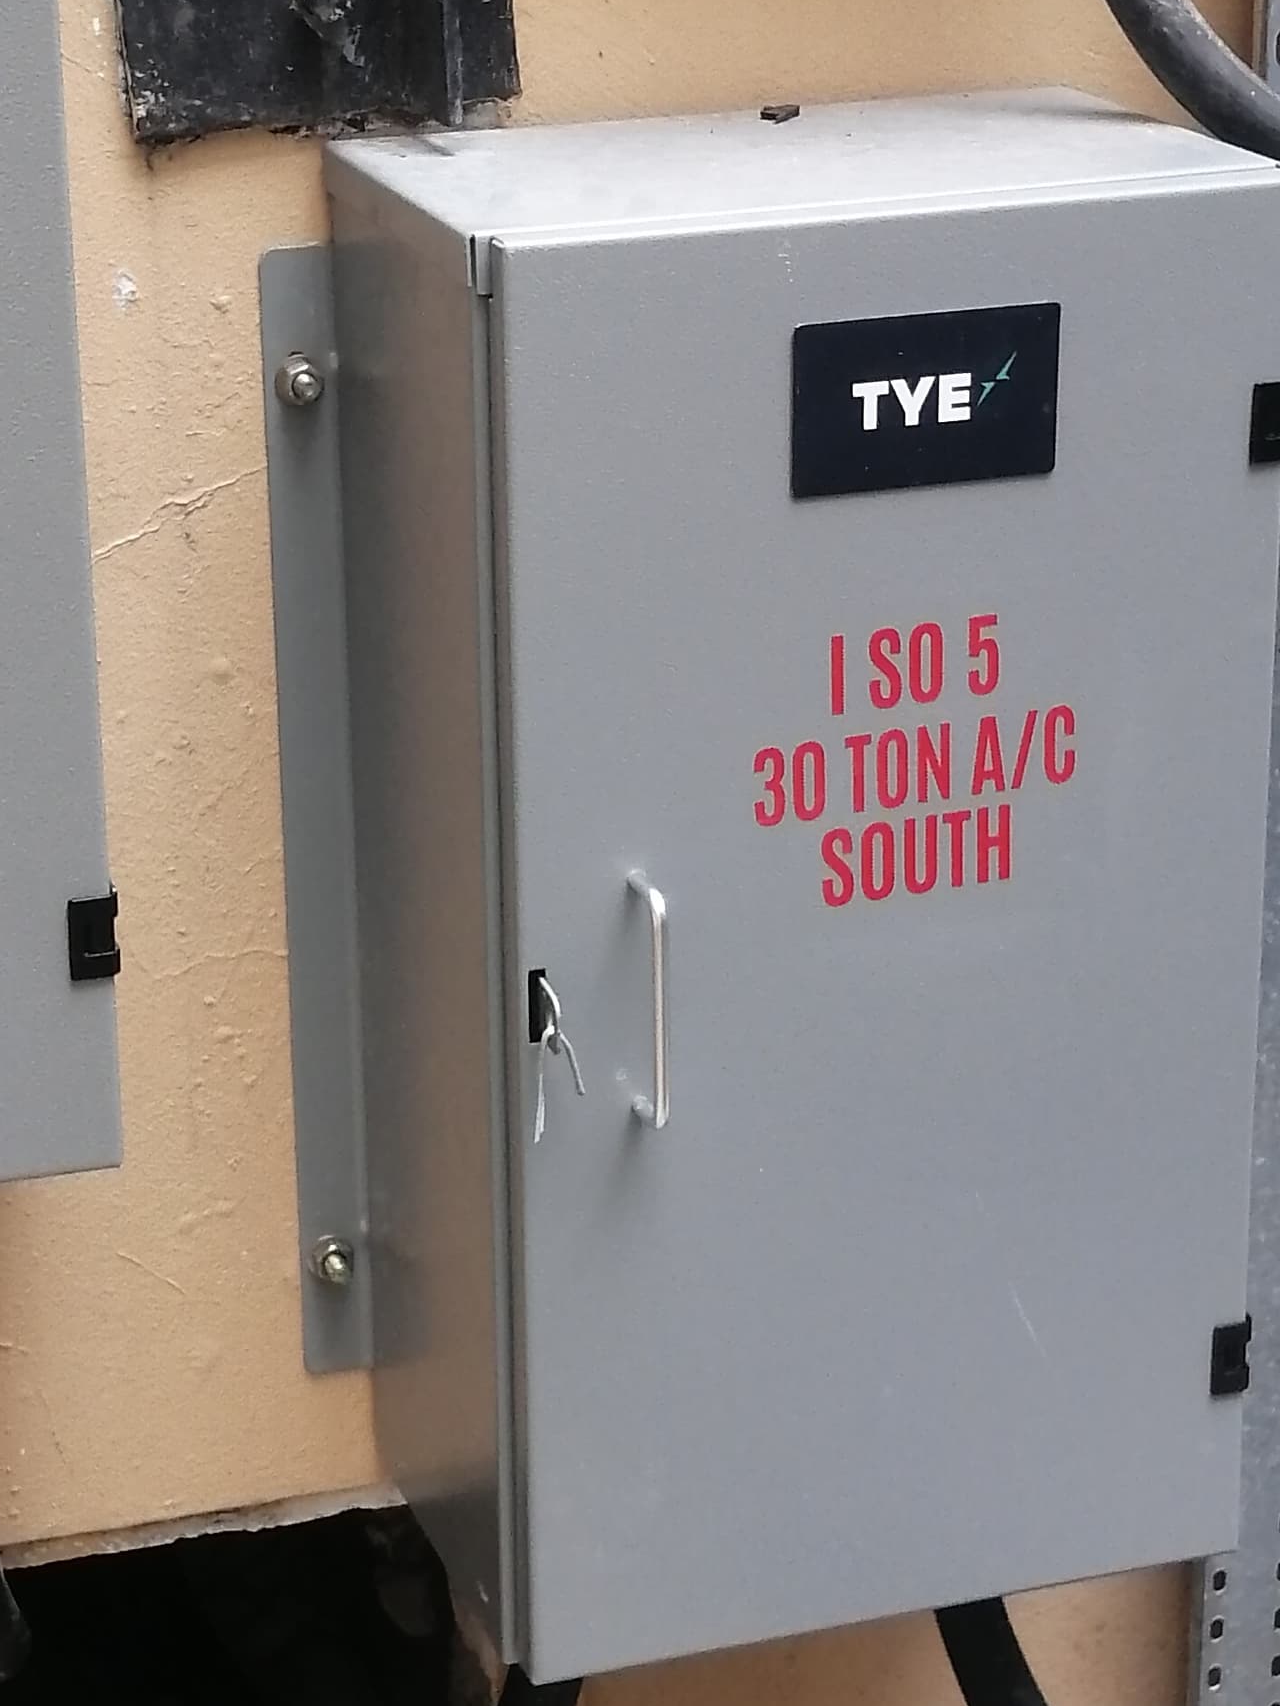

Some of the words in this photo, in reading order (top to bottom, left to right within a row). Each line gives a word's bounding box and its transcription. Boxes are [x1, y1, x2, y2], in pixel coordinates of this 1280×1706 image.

[852, 372, 972, 431] TYE
[967, 613, 1000, 696] 5
[753, 740, 827, 827] 30
[844, 721, 951, 813] TON
[971, 704, 1076, 796] A/C
[821, 803, 1012, 907] SOUTH
